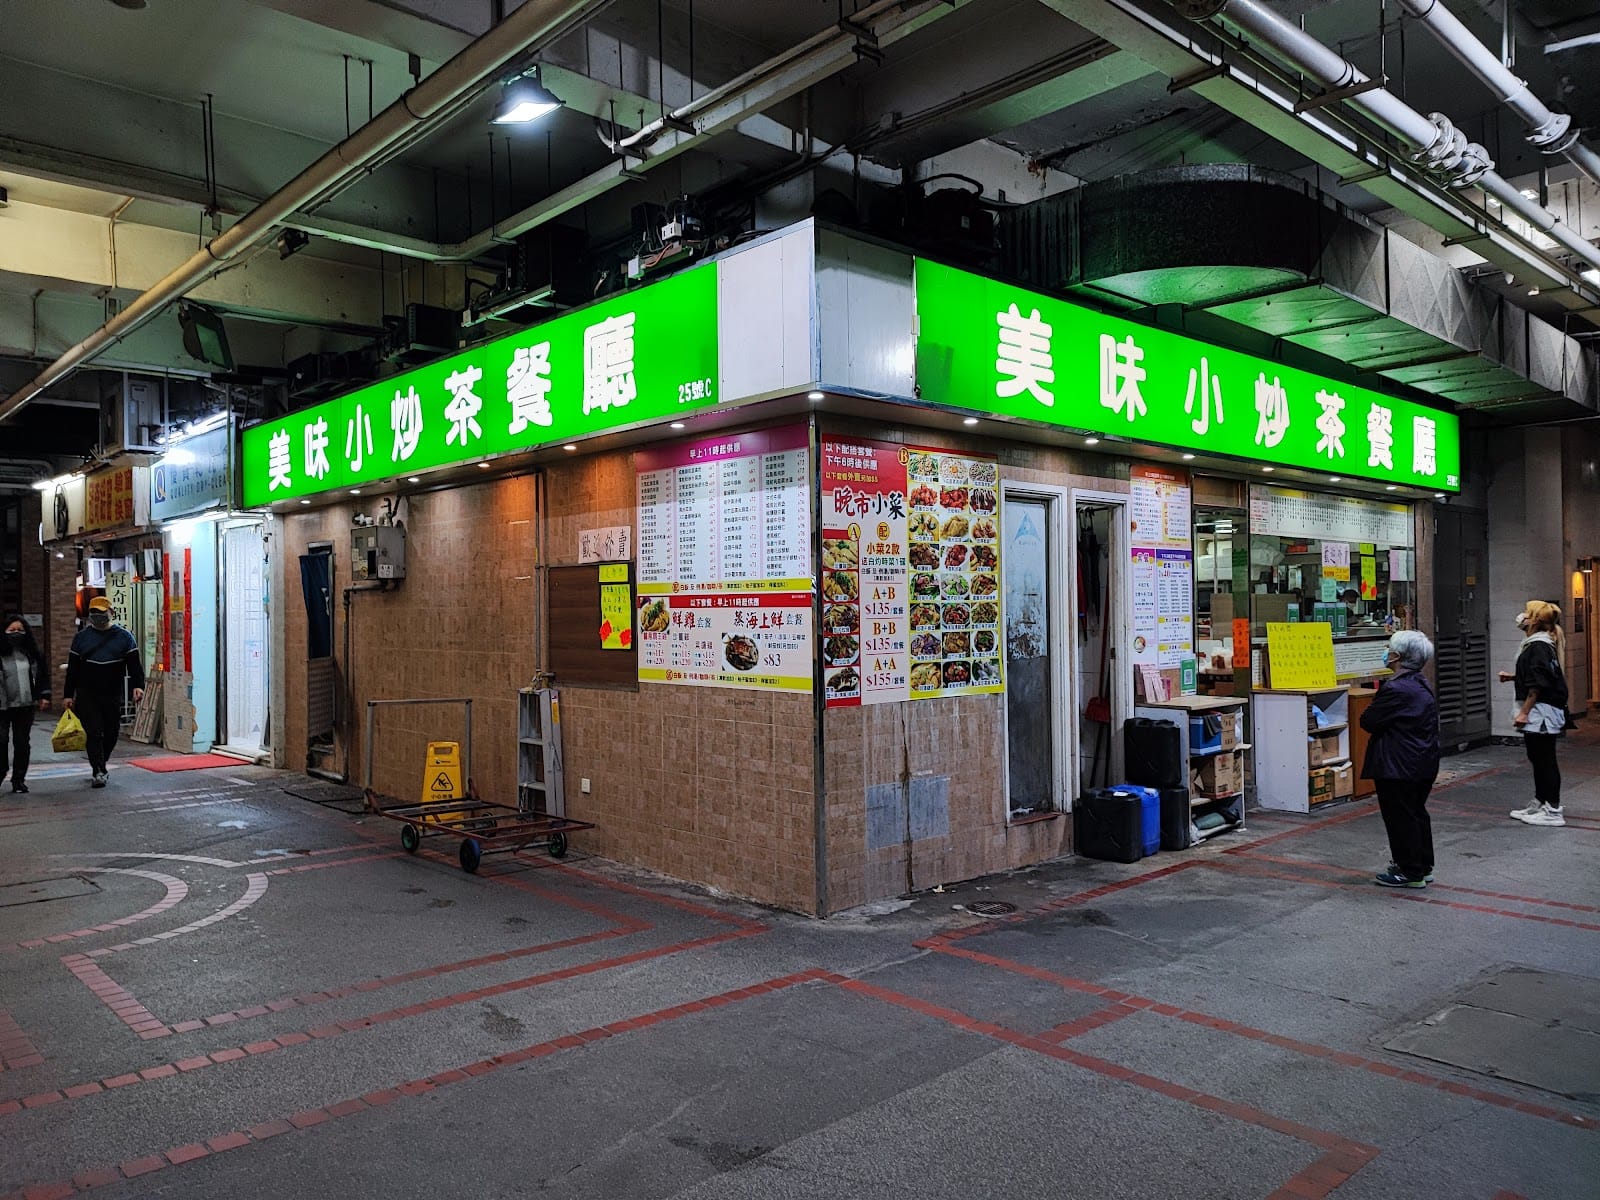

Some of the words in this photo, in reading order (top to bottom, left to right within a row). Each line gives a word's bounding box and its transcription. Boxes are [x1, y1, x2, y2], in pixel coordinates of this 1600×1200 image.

[268, 311, 637, 492] 美味小炒茶餐廳
[678, 378, 712, 404] 25號C
[996, 302, 1436, 476] 美味小炒茶餐廳
[833, 487, 906, 520] 晚市小菜
[111, 573, 128, 629] 冠奇鋁
[873, 586, 896, 600] A+B
[873, 622, 896, 635] B+B
[874, 657, 897, 671] A+A
